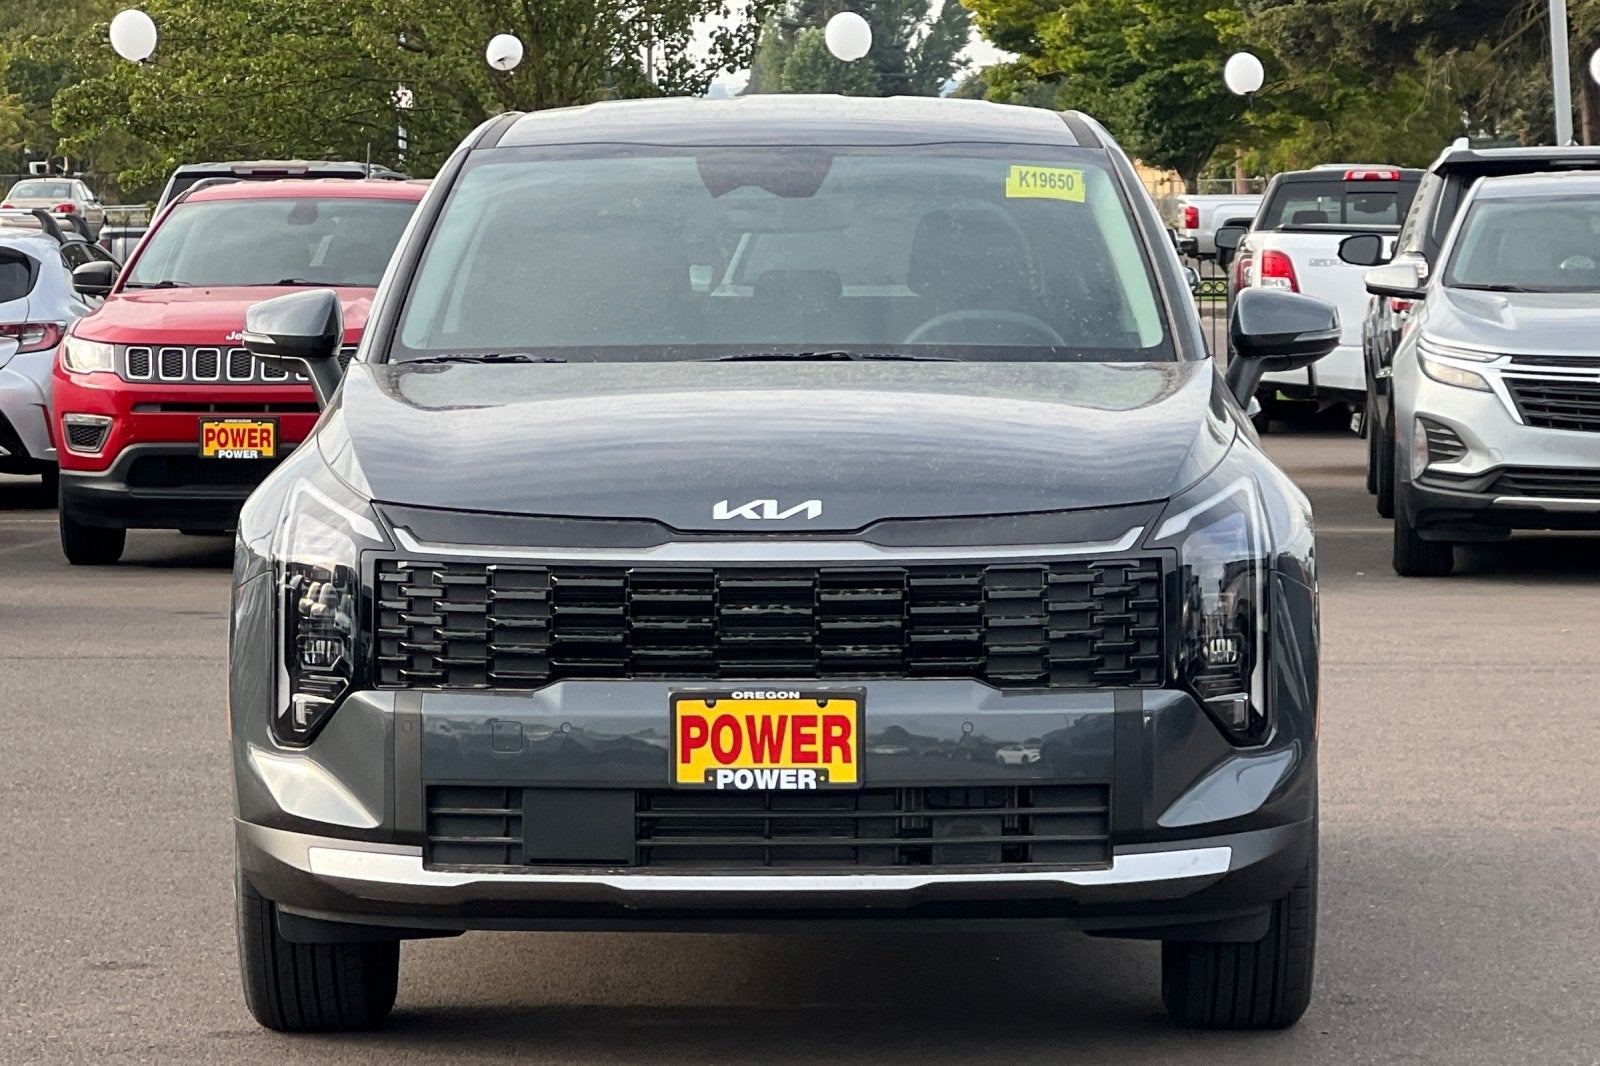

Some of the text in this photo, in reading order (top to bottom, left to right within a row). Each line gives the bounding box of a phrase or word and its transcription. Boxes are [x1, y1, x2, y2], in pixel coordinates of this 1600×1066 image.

[1019, 171, 1074, 191] K19650
[225, 331, 243, 341] Je
[205, 427, 272, 448] POWER
[218, 450, 258, 459] POWER
[712, 499, 823, 520] KIA
[731, 691, 801, 699] OREGON
[681, 714, 852, 765] POWER
[716, 769, 817, 790] POWER
